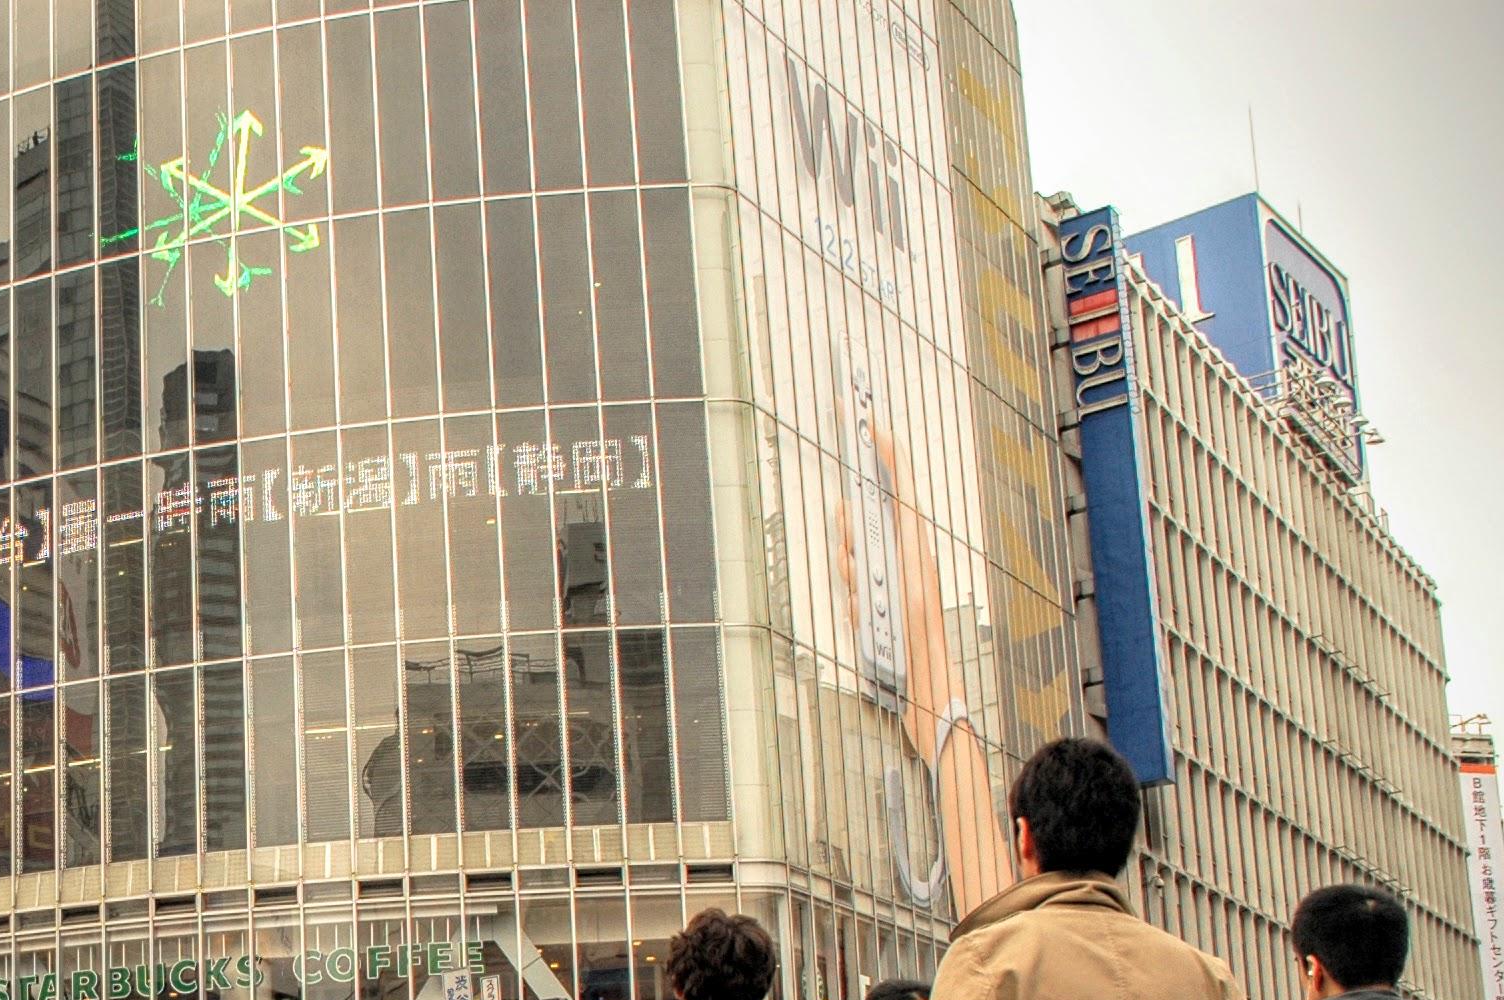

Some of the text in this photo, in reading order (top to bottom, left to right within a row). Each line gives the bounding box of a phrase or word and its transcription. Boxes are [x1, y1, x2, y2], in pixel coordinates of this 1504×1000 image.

[783, 52, 904, 252] Wii
[1061, 224, 1128, 421] SEIBU
[1268, 262, 1349, 384] SEIBU
[292, 941, 484, 984] COFFEE
